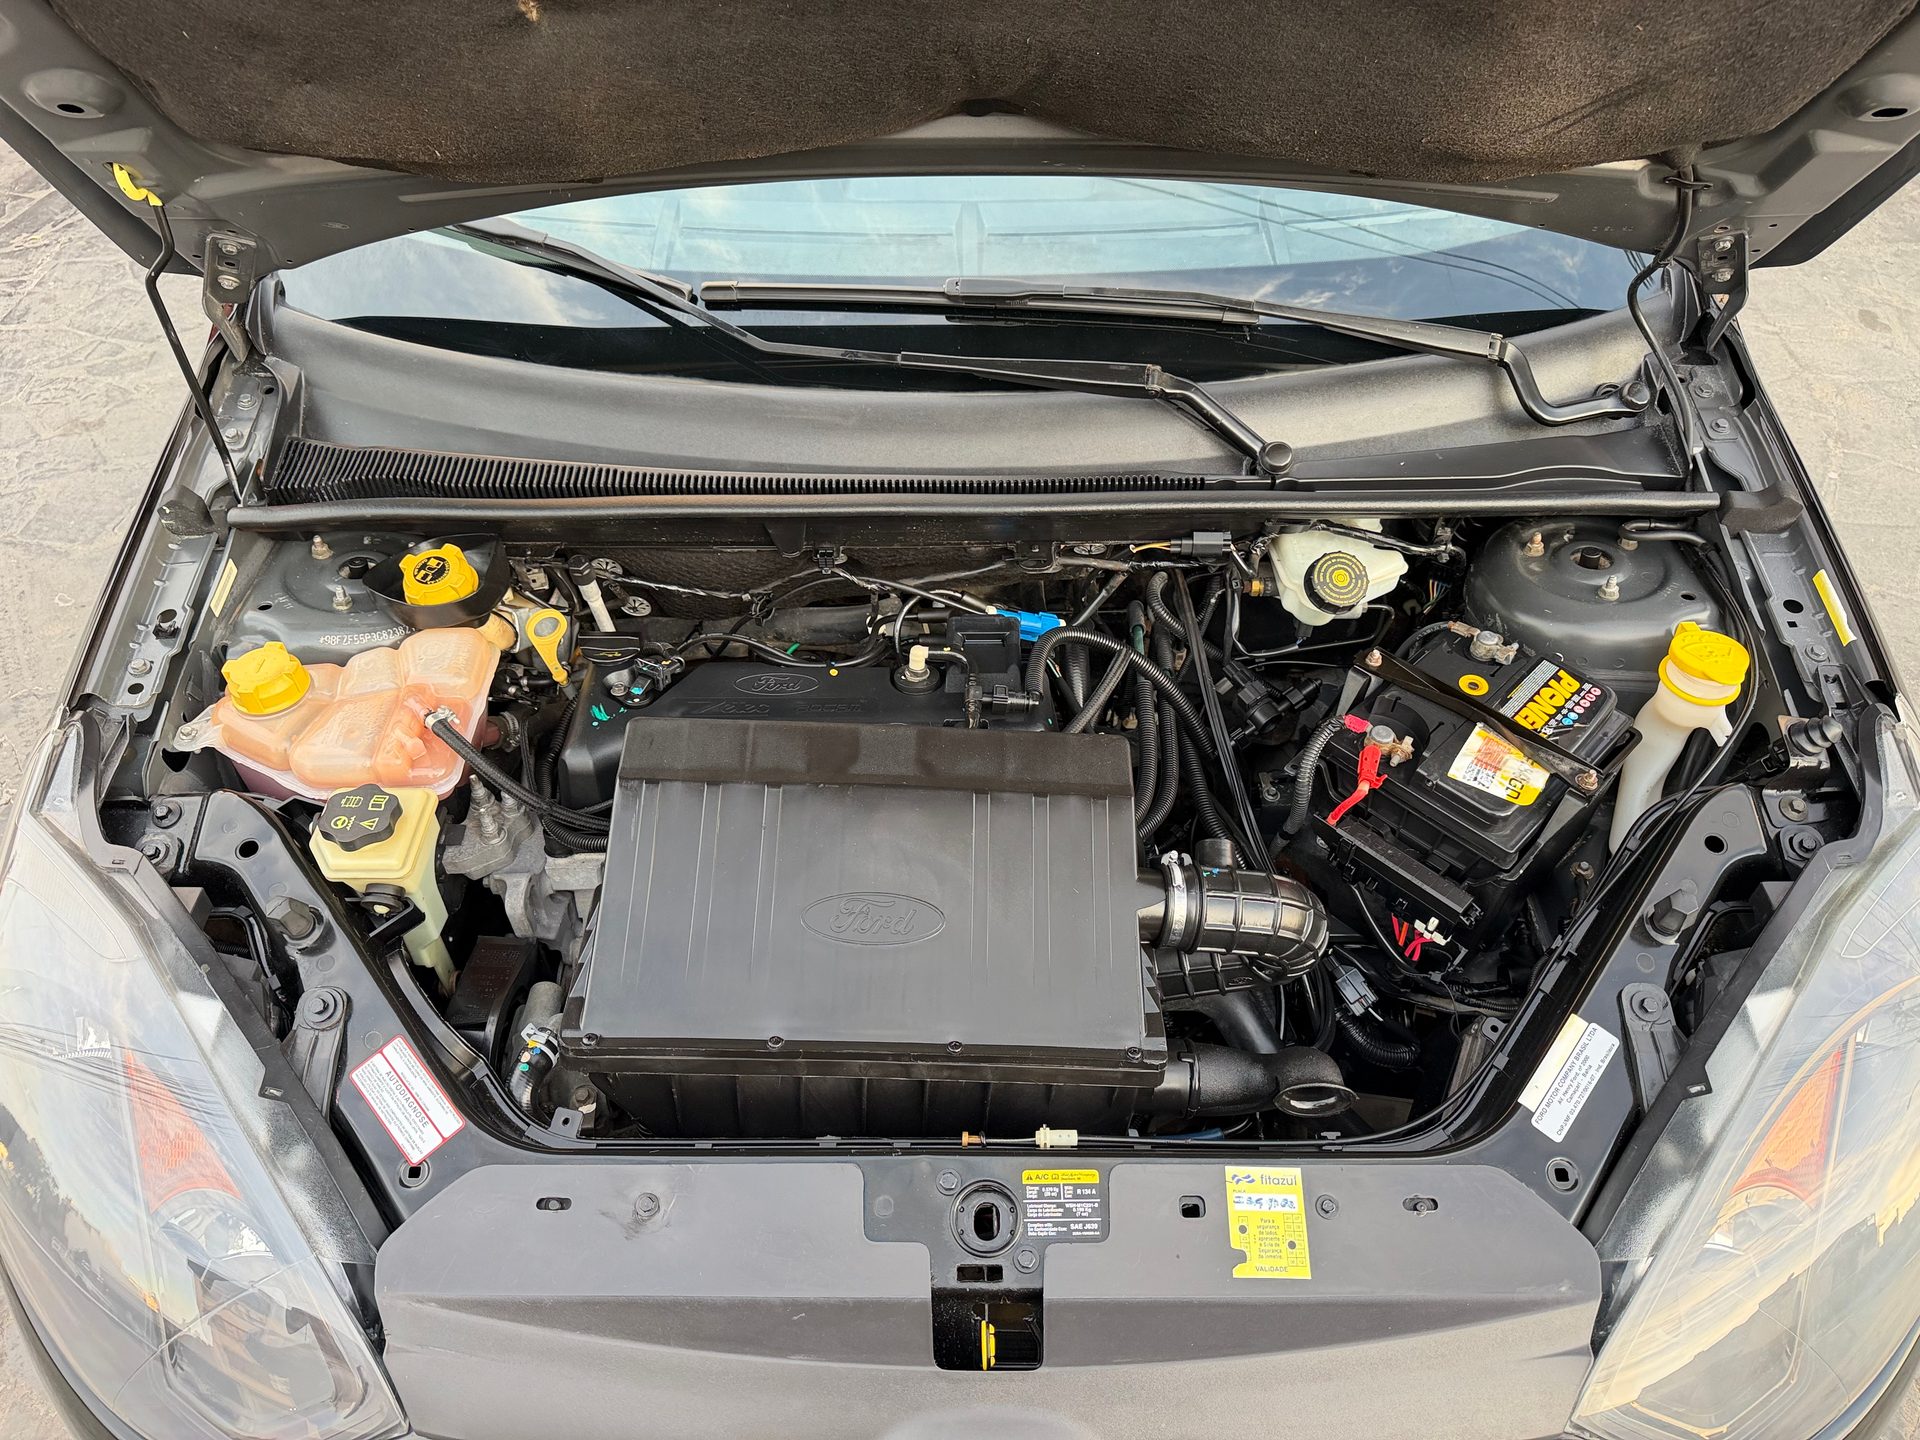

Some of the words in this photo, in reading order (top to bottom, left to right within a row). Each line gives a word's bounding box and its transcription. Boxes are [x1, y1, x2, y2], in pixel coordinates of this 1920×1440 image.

[752, 675, 801, 691] Ford
[830, 898, 917, 935] Ford
[1535, 1108, 1548, 1125] FORD
[1545, 1087, 1561, 1109] MOTOR
[1560, 1061, 1577, 1087] COMPANY
[1574, 1042, 1590, 1062] BRASIL
[1587, 1027, 1598, 1045] LTDA
[384, 1070, 430, 1129] AUTODIAGNOSE
[1260, 1174, 1297, 1186] fitazul
